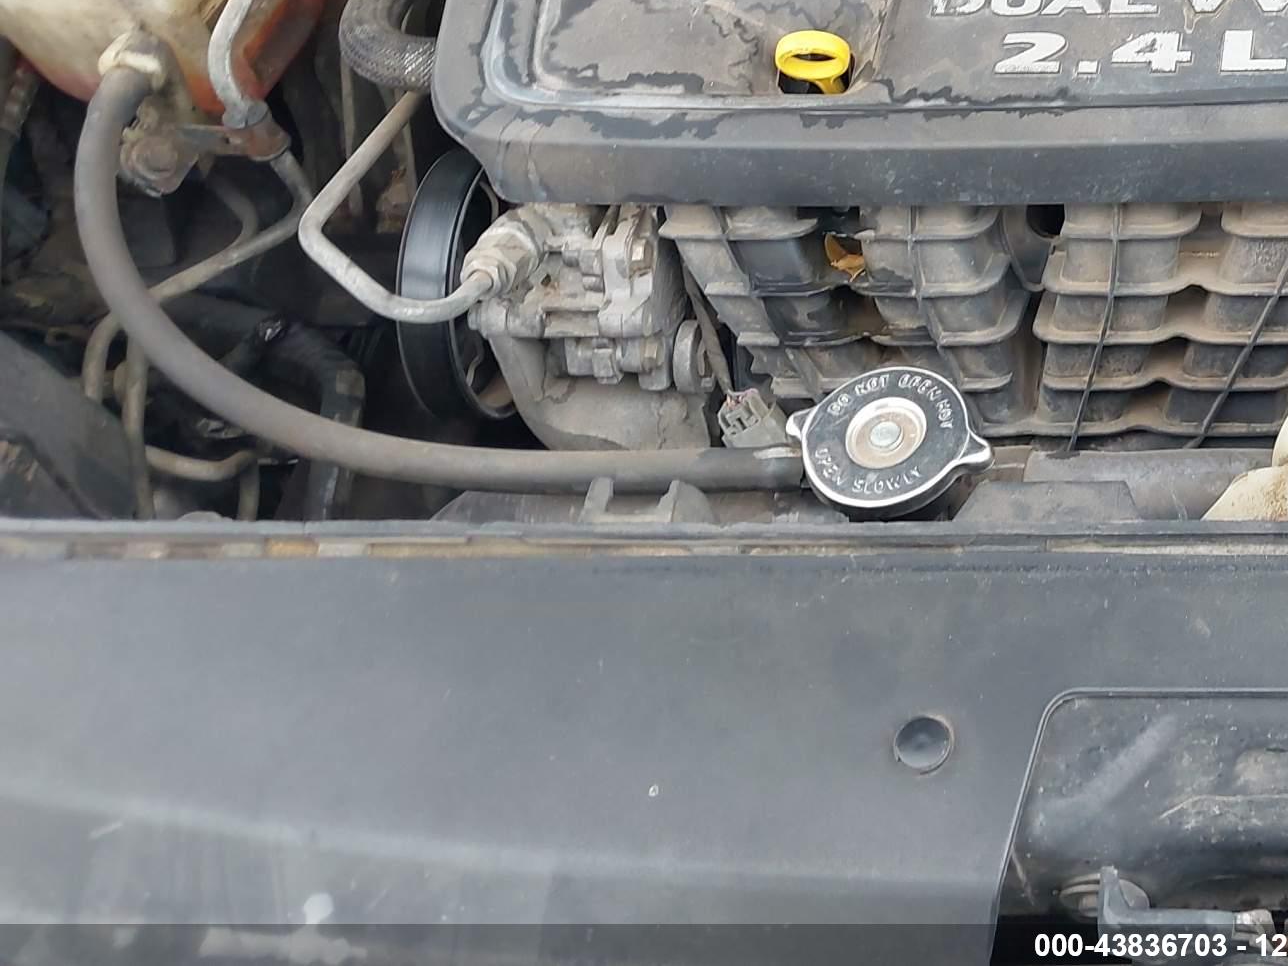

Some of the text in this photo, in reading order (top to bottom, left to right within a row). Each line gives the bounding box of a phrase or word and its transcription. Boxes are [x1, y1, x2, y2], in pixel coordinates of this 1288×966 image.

[853, 374, 890, 396] NOT
[897, 373, 943, 401] OPEN
[814, 447, 922, 495] OPEN SLOWLY
